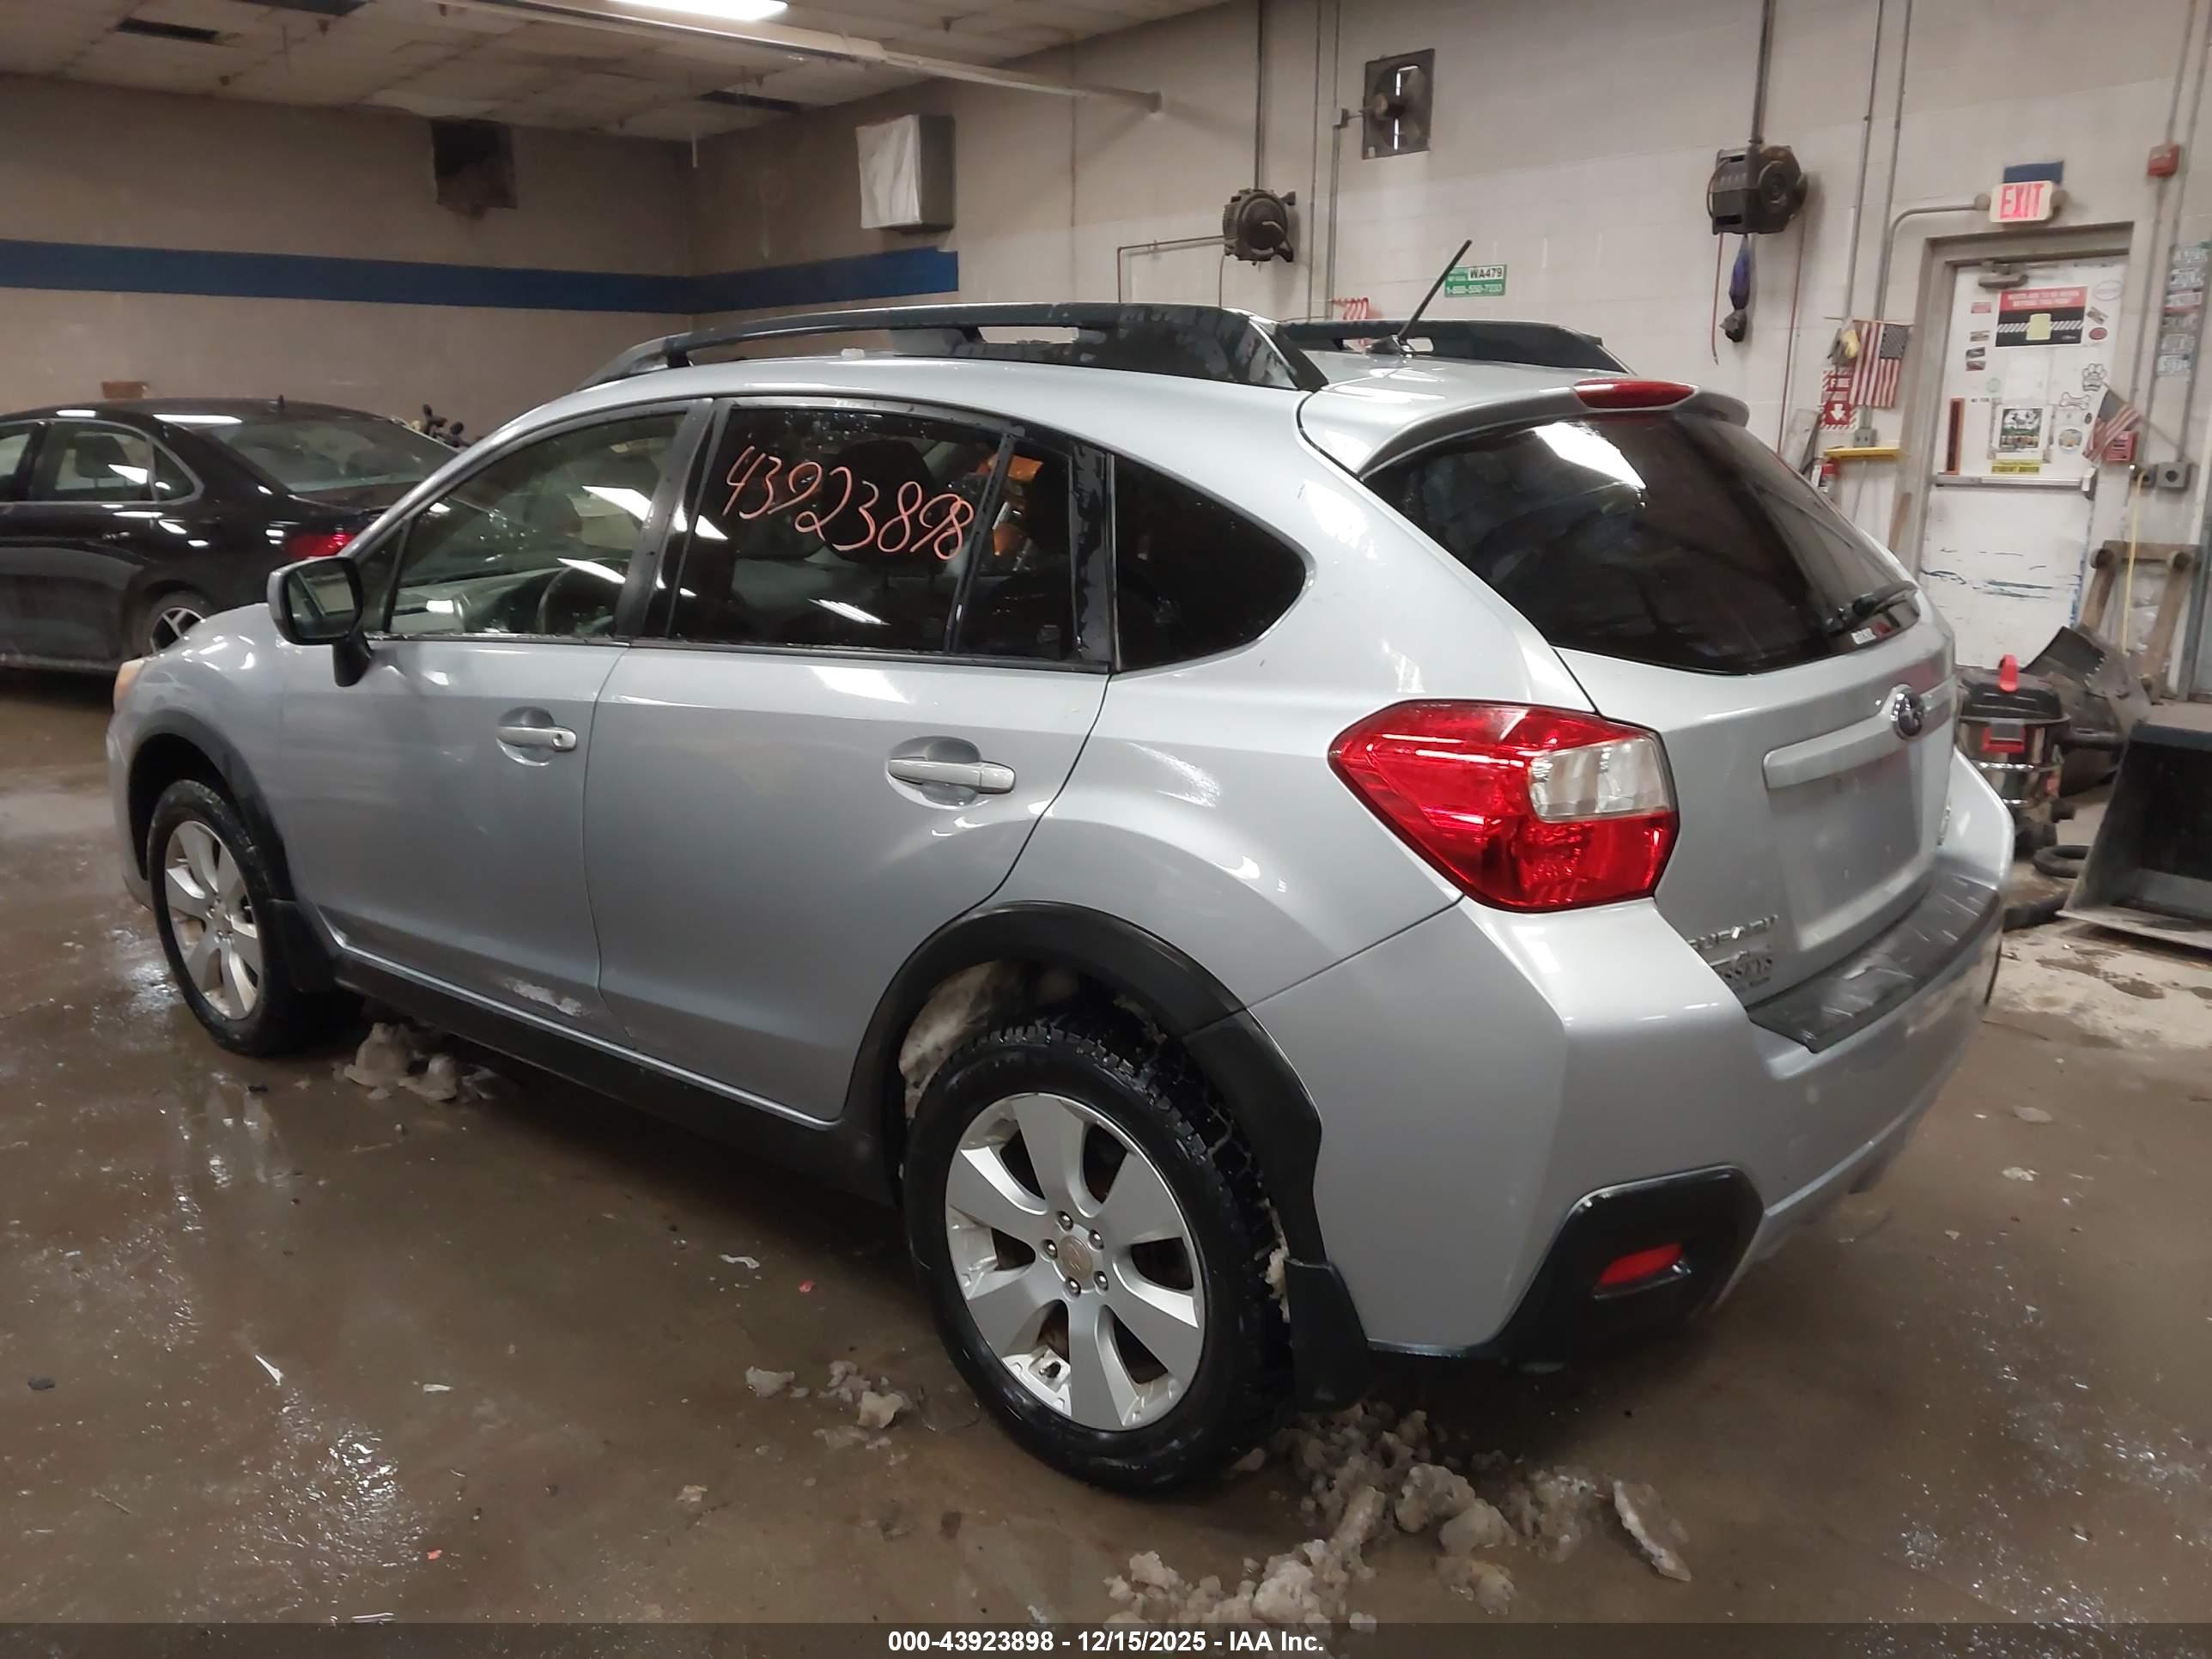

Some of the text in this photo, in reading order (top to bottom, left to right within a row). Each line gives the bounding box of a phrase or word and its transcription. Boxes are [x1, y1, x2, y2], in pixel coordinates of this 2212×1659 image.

[1999, 183, 2046, 220] EXIT
[1469, 267, 1503, 279] WA479
[722, 445, 975, 560] 43923898
